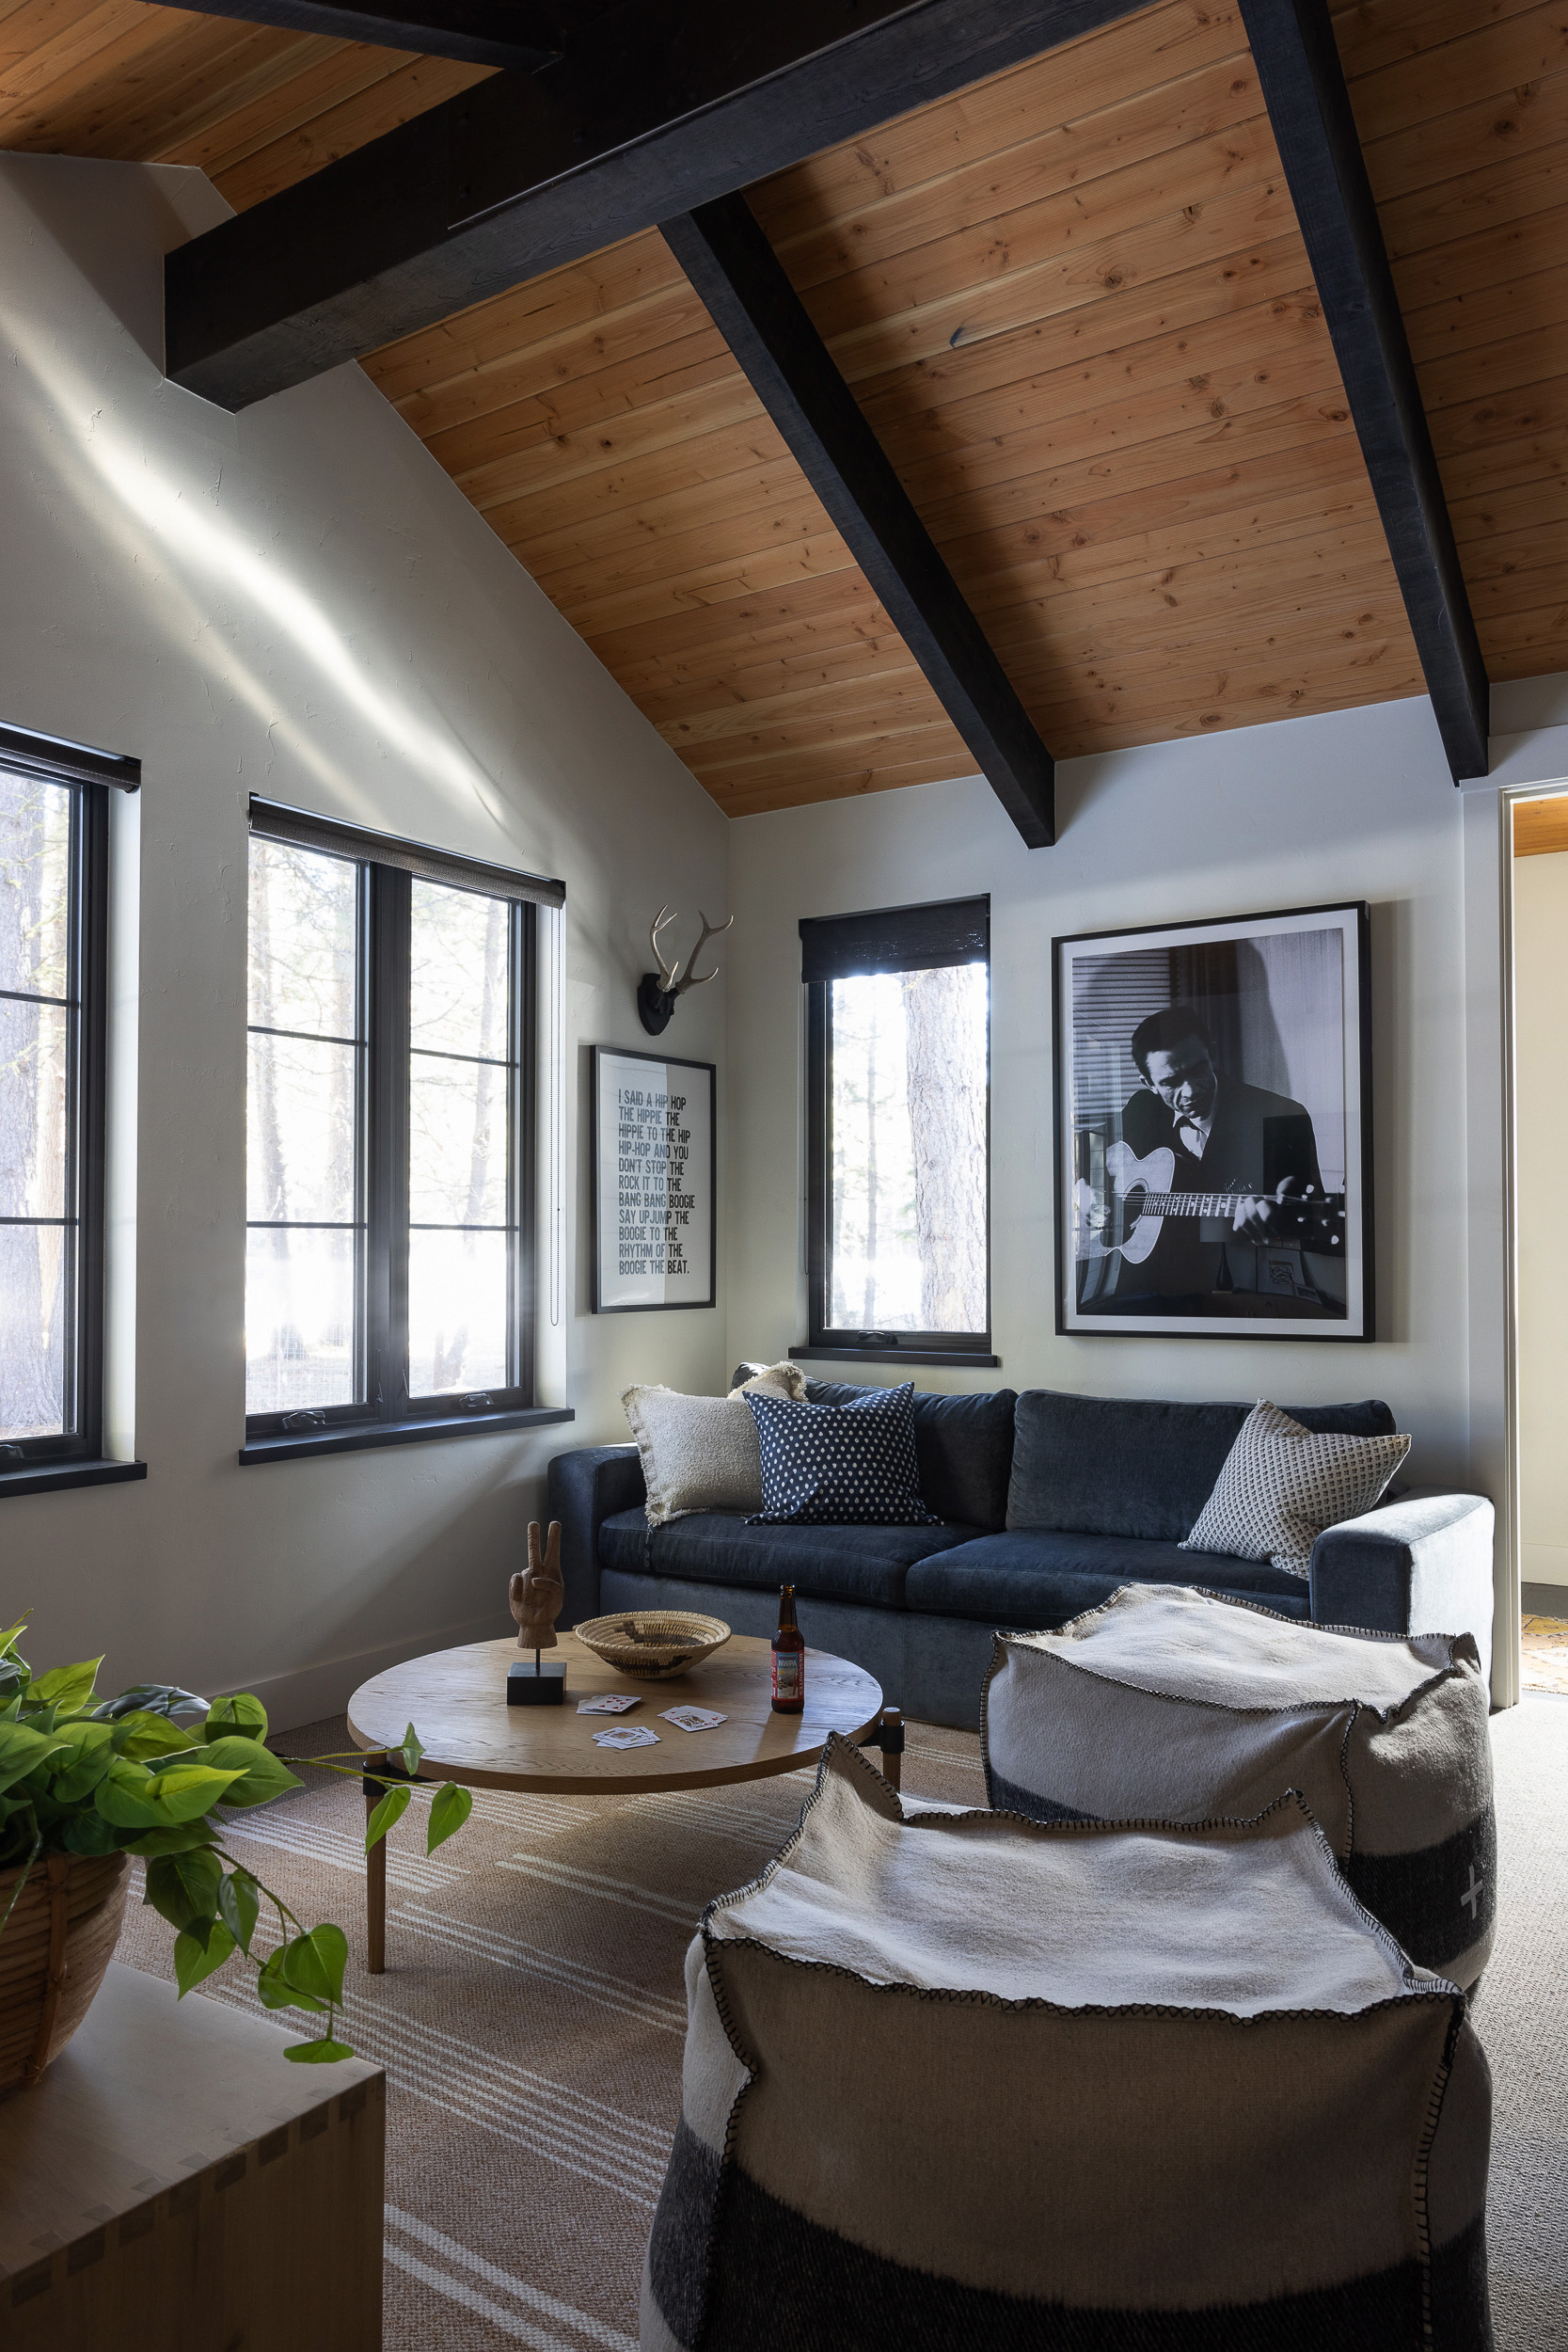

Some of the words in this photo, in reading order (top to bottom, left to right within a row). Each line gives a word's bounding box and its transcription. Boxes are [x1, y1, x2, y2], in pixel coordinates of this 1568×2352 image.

[625, 1089, 642, 1105] SAID
[646, 1092, 652, 1107] A
[656, 1093, 668, 1108] HIP
[671, 1095, 687, 1110] HOP
[619, 1105, 634, 1121] THE
[638, 1108, 662, 1124] HIPPIE
[665, 1111, 680, 1126] THE
[619, 1123, 643, 1139] HIPPIE
[647, 1126, 657, 1140] TO
[660, 1128, 675, 1142] THE
[678, 1129, 690, 1143] HIP
[619, 1140, 650, 1156] HIP-HOP
[654, 1143, 671, 1158] AND
[673, 1146, 689, 1160] YOU
[619, 1158, 642, 1173] DON'T
[645, 1160, 666, 1174] STOP
[670, 1162, 685, 1175] THE
[619, 1175, 640, 1190] ROCK
[643, 1176, 650, 1190] IT
[654, 1177, 664, 1191] TO
[667, 1178, 682, 1192] THE
[619, 1192, 641, 1206] BANG
[644, 1193, 666, 1208] BANG
[669, 1194, 695, 1209] BOOGIE
[619, 1209, 636, 1224] SAY
[674, 1211, 689, 1225] THE
[619, 1226, 646, 1241] BOOGIE
[650, 1227, 660, 1241] TO
[663, 1227, 678, 1241] THE
[619, 1243, 653, 1258] RHYTHM
[656, 1244, 665, 1258] OF
[668, 1244, 683, 1258] THE
[619, 1260, 646, 1275] BOOGIE
[650, 1260, 665, 1274] THE
[667, 1260, 689, 1275] BEAT.
